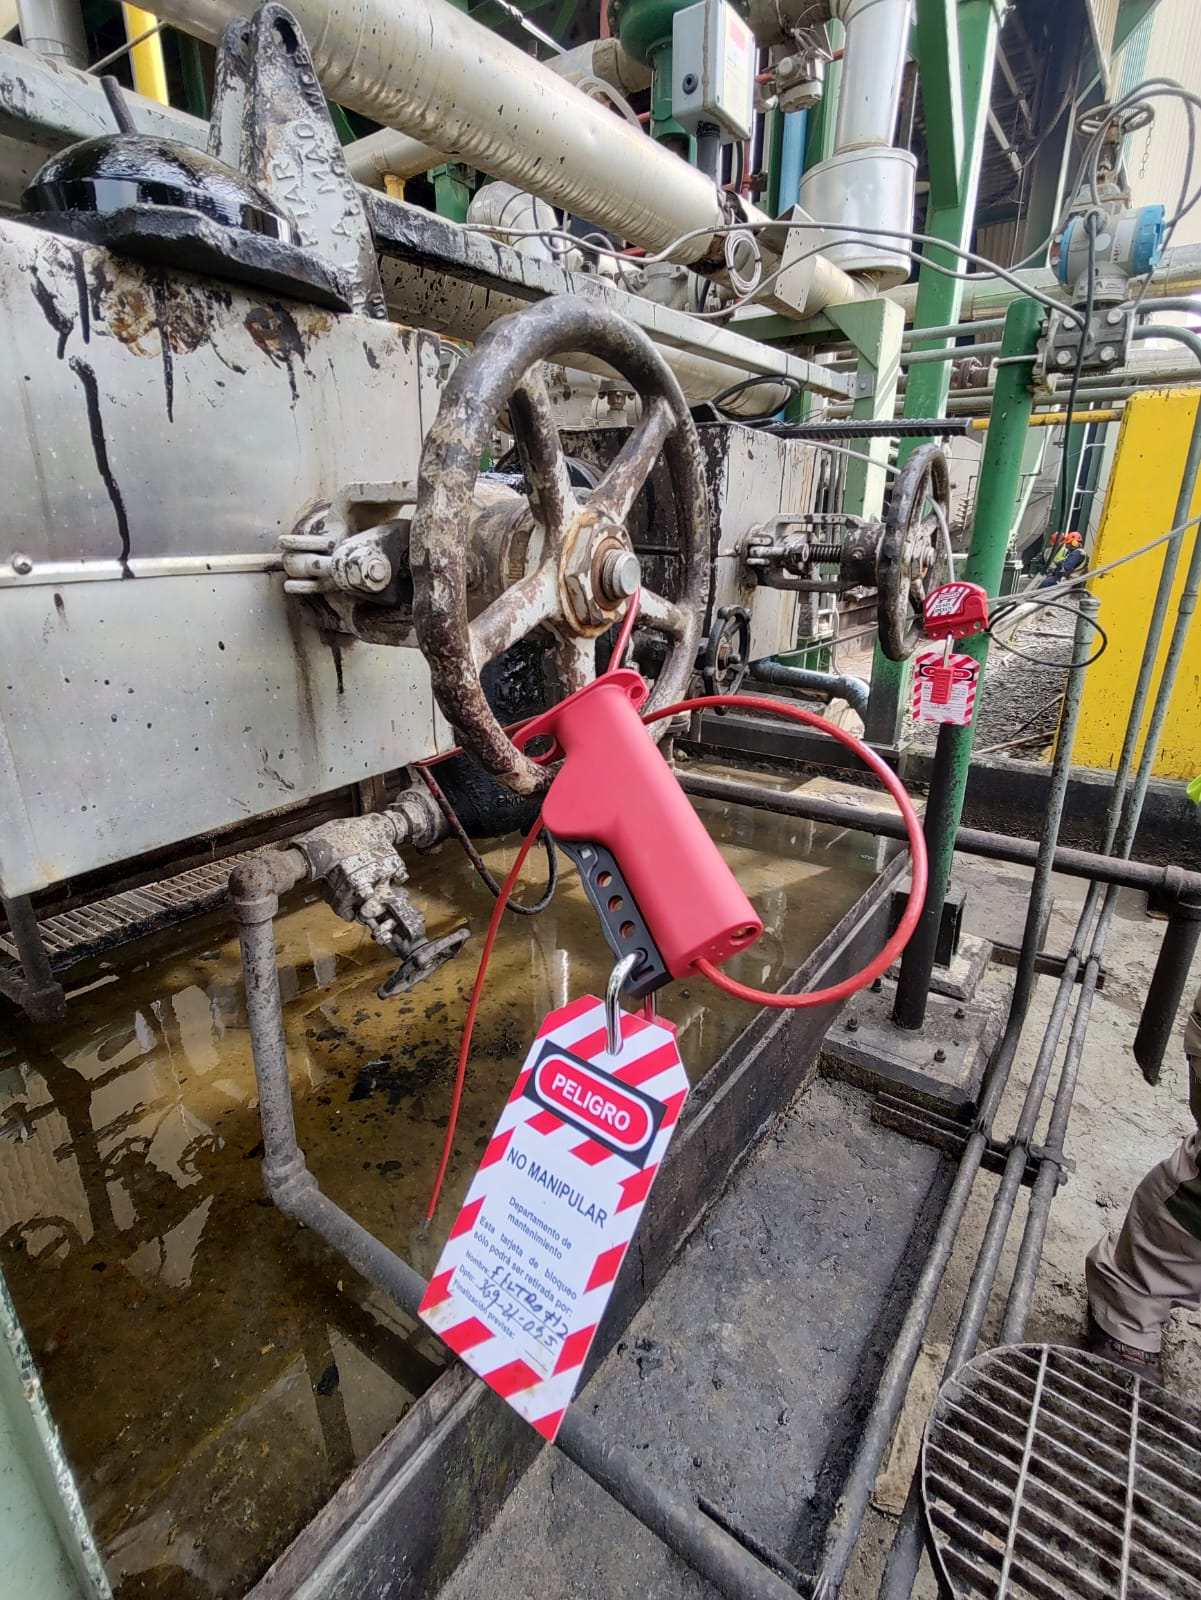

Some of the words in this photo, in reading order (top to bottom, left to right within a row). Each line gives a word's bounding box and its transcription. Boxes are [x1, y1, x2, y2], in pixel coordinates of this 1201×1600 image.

[552, 1073, 631, 1131] PELIGRO
[507, 1147, 527, 1170] NO
[527, 1161, 608, 1229] MANIPULAR
[507, 1213, 563, 1260] mantenimiento
[509, 1197, 560, 1241] Departamento
[562, 1235, 573, 1250] de
[459, 1264, 477, 1283] Dpto:
[473, 1231, 489, 1248] sólo
[489, 1244, 511, 1266] podrá
[512, 1262, 525, 1276] ser
[524, 1271, 554, 1303] retirada
[555, 1298, 573, 1318] por:
[479, 1216, 496, 1234] Esta
[500, 1233, 524, 1257] tarjeta
[528, 1256, 539, 1269] de
[544, 1268, 577, 1300] bloqueo
[453, 1279, 489, 1315] Finalización
[487, 1311, 515, 1340] prevista:
